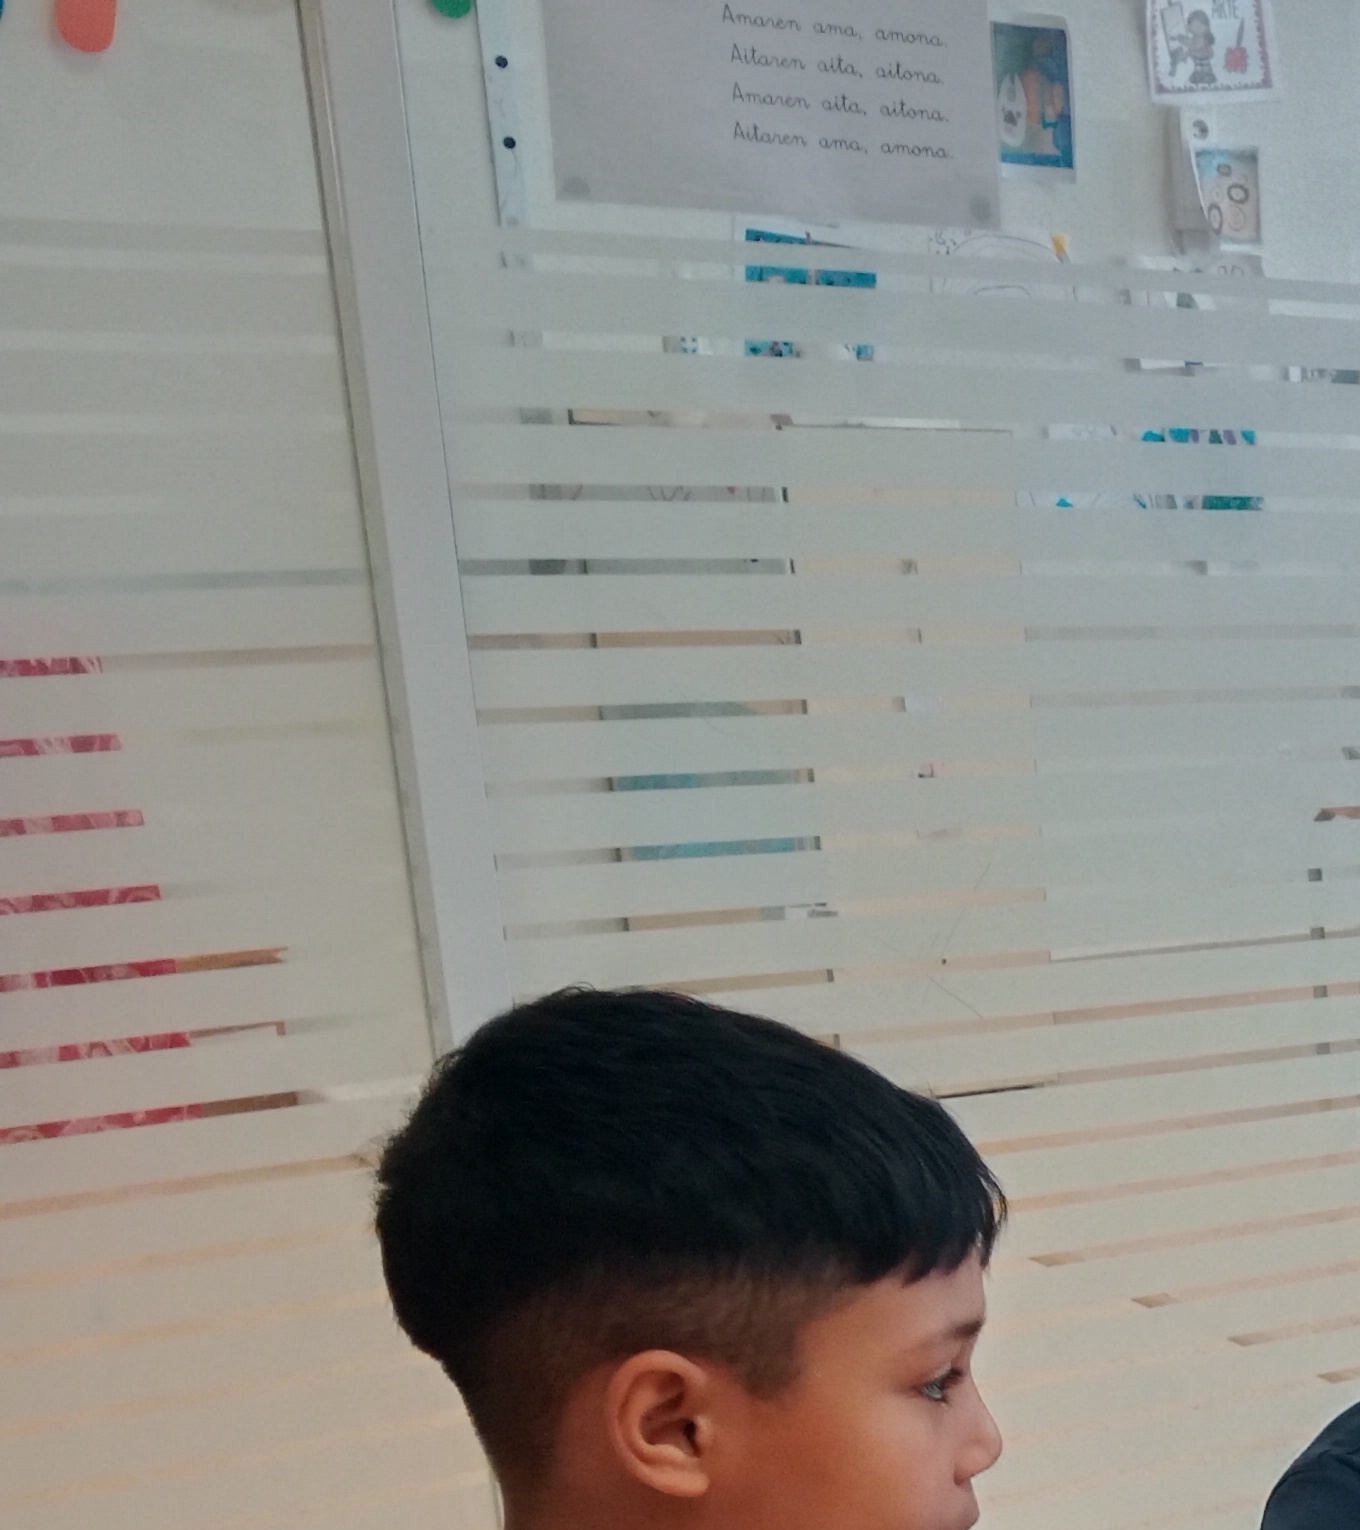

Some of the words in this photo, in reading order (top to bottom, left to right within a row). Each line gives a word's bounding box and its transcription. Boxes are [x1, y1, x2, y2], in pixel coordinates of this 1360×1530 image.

[722, 3, 801, 31] Amaren
[812, 21, 863, 41] ama,
[875, 27, 948, 48] amona.
[730, 43, 806, 71] Aitaren
[817, 54, 863, 78] aita,
[875, 63, 944, 85] aitona.
[732, 82, 810, 110] Amaren
[821, 93, 867, 116] aita,
[880, 101, 950, 122] aitona.
[733, 121, 808, 148] Aitaren
[819, 136, 868, 154] ama,
[880, 143, 954, 160] amona.
